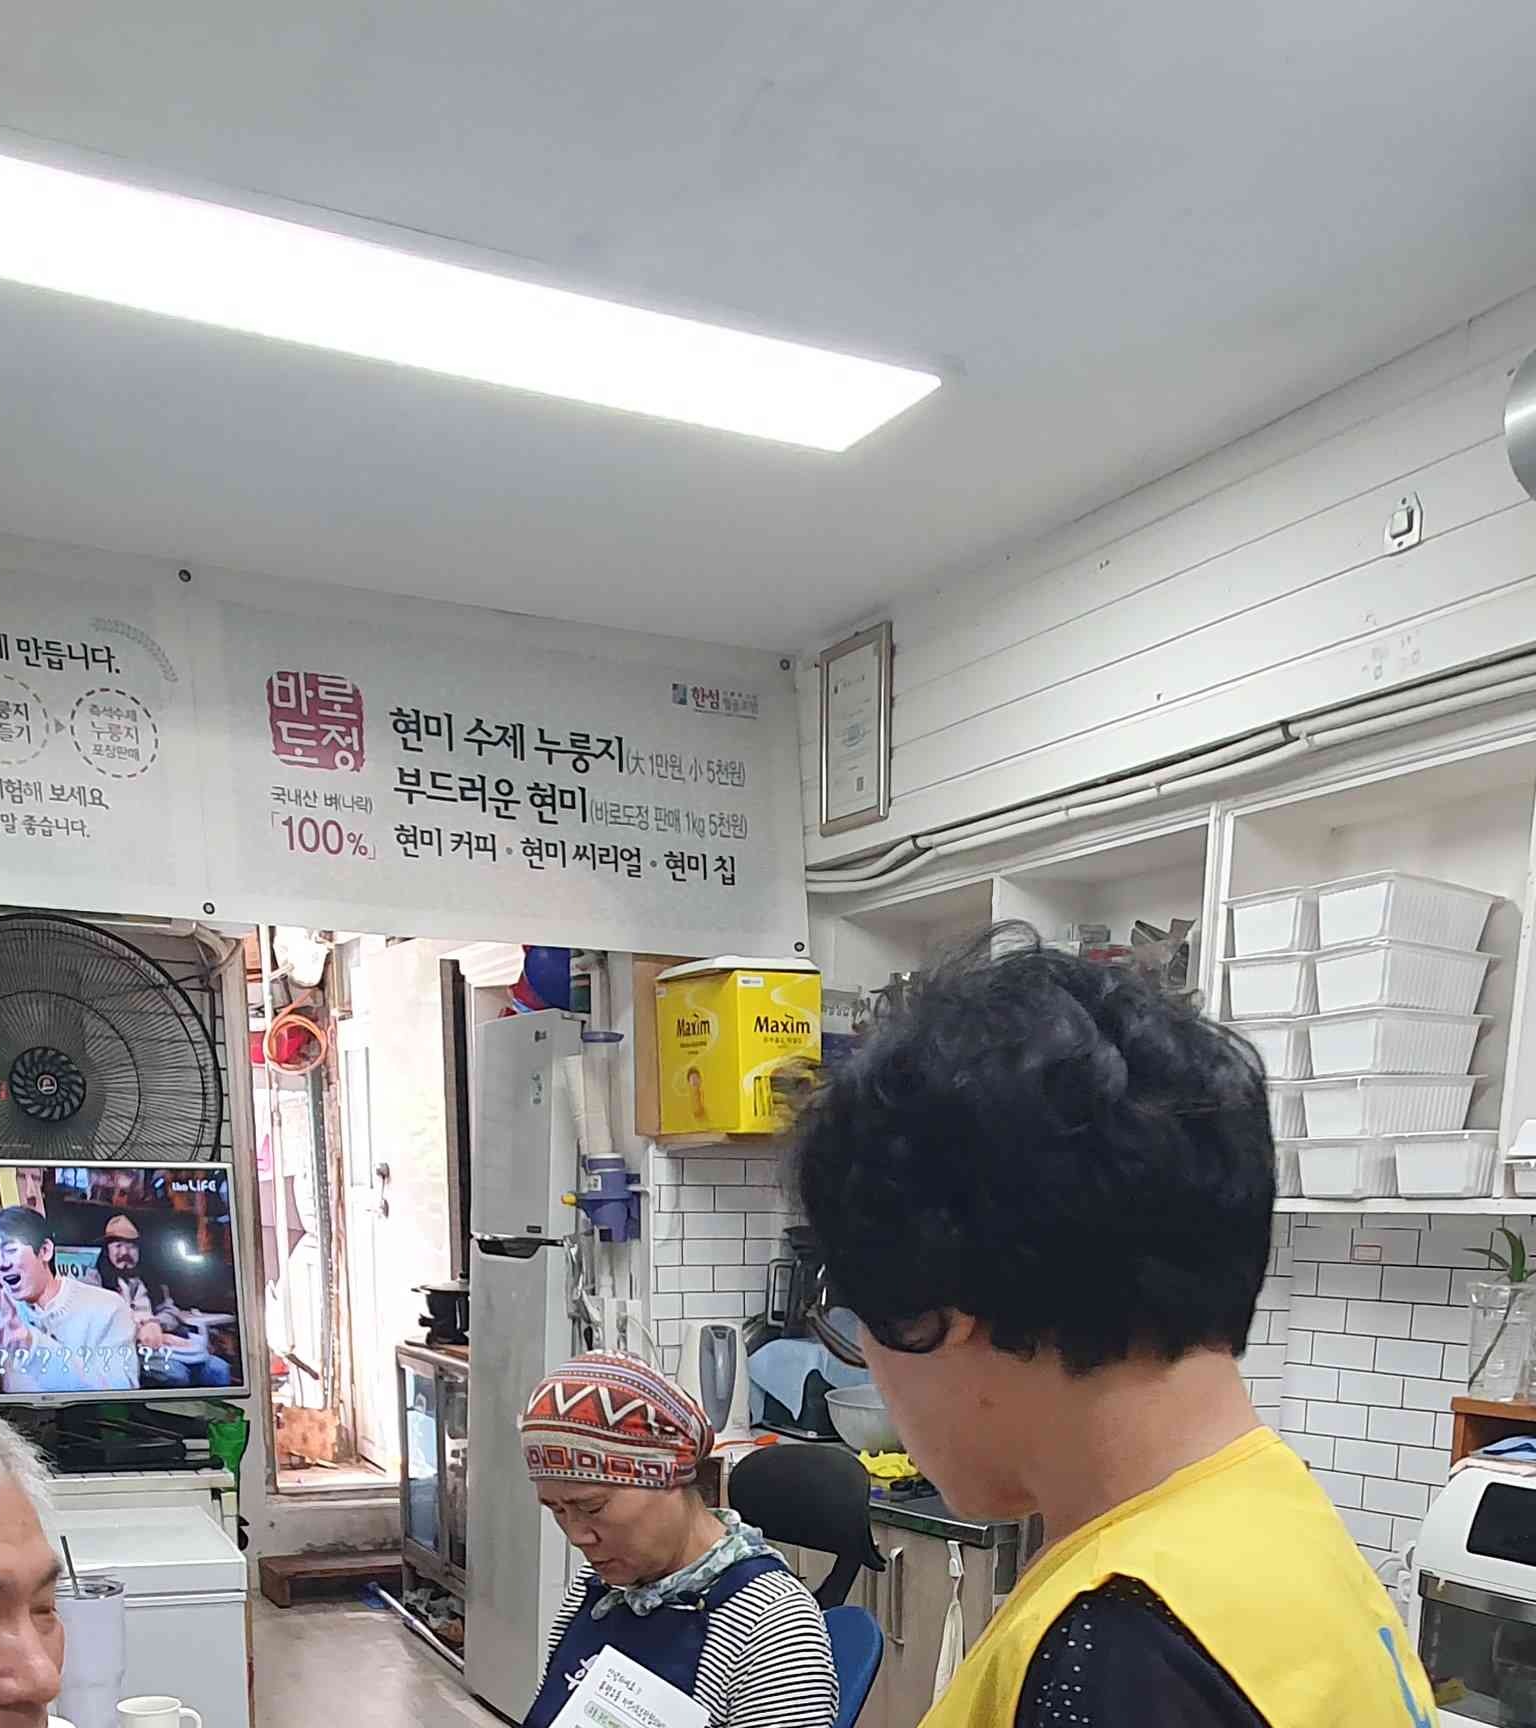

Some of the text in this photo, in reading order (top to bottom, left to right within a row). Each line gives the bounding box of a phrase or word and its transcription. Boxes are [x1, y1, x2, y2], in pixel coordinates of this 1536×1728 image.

[15, 635, 122, 675] 만듭니다.
[271, 672, 358, 720] 바로
[275, 720, 362, 773] 도정
[389, 706, 455, 755] 현미
[463, 717, 527, 764] 수제
[270, 785, 320, 810] 국내산
[393, 766, 523, 820] 부드러운
[528, 779, 589, 825] 현미
[394, 823, 737, 887] 현미 커피 현미 씨리얼 현미 칩
[676, 1013, 712, 1038] Maxim
[754, 1014, 811, 1034] Maxim
